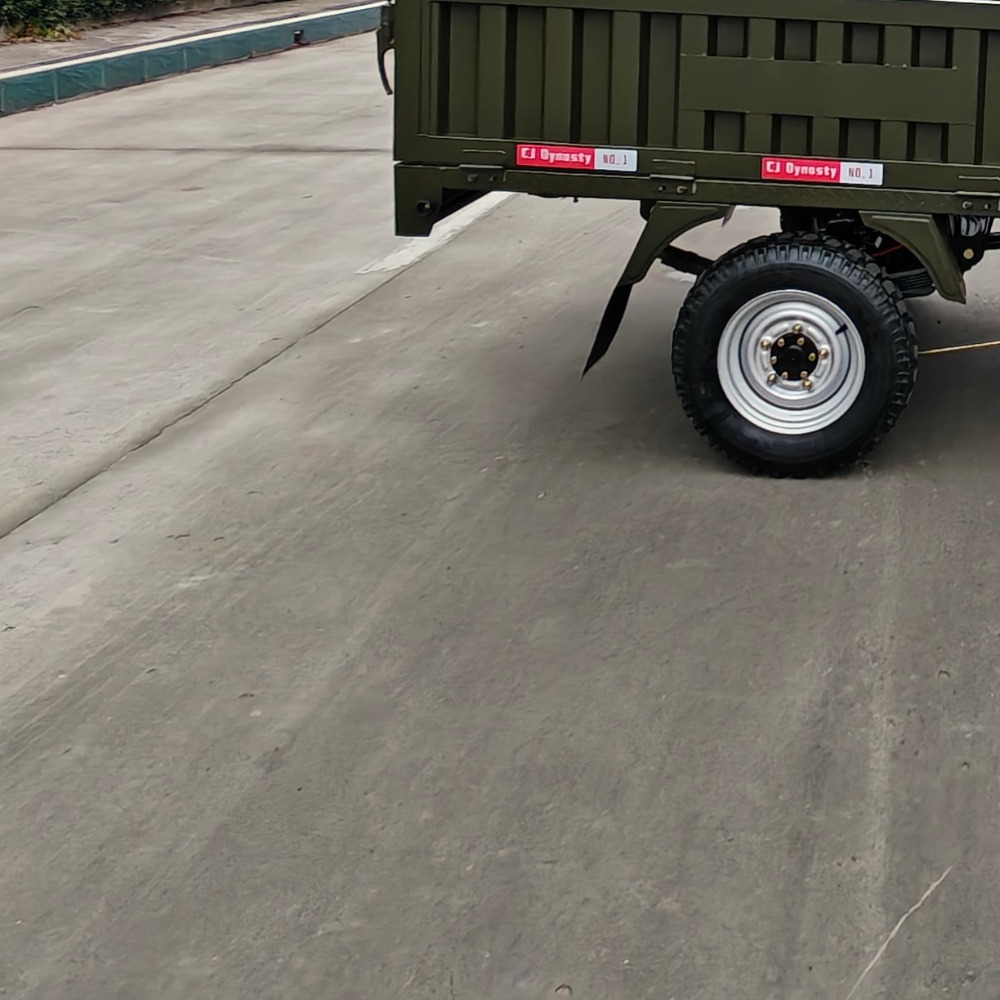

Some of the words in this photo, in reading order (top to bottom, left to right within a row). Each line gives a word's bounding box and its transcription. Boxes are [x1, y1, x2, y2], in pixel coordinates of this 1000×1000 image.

[540, 148, 592, 165] Dynasty
[766, 161, 780, 173] CJ
[785, 162, 837, 179] Dynasty
